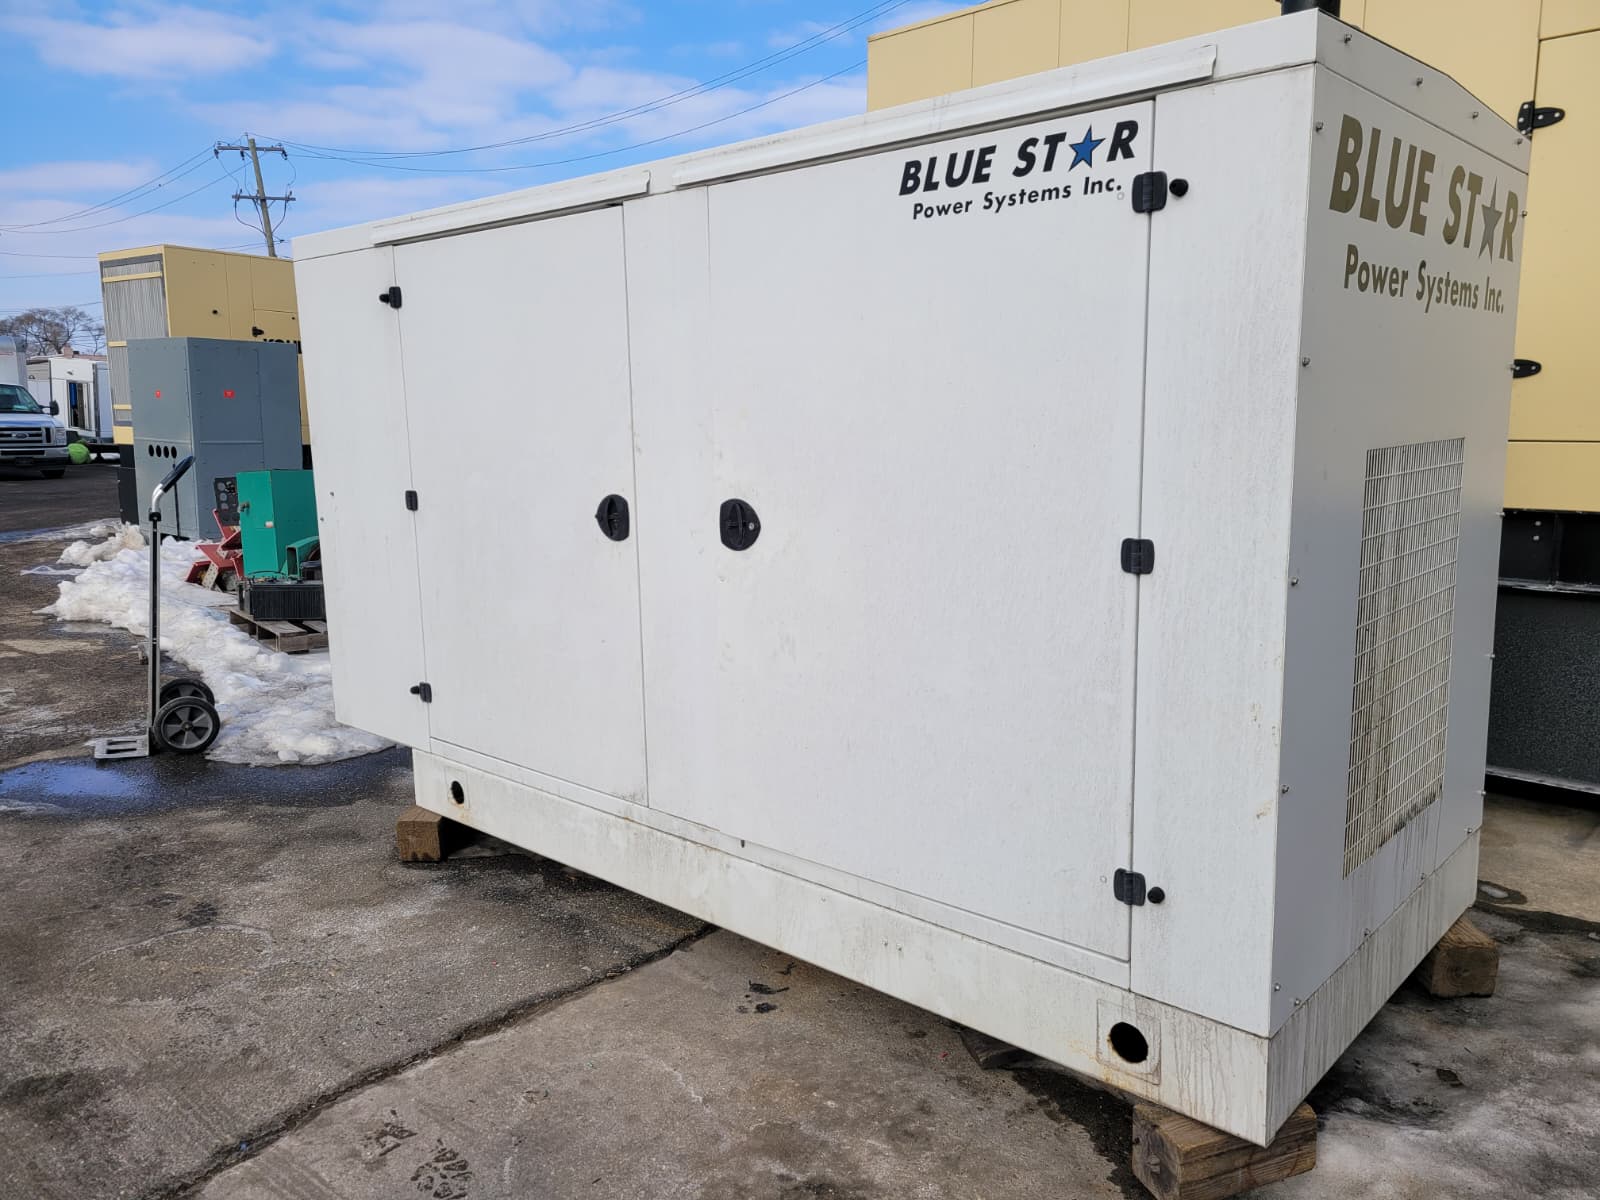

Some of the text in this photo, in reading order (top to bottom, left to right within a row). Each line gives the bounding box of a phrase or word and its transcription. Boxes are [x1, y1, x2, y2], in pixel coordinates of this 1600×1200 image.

[898, 145, 997, 196] BLUE
[912, 176, 1122, 220] Power Systems Inc.
[1329, 114, 1436, 236] BLUE
[1344, 244, 1504, 314] Power Systems Inc.
